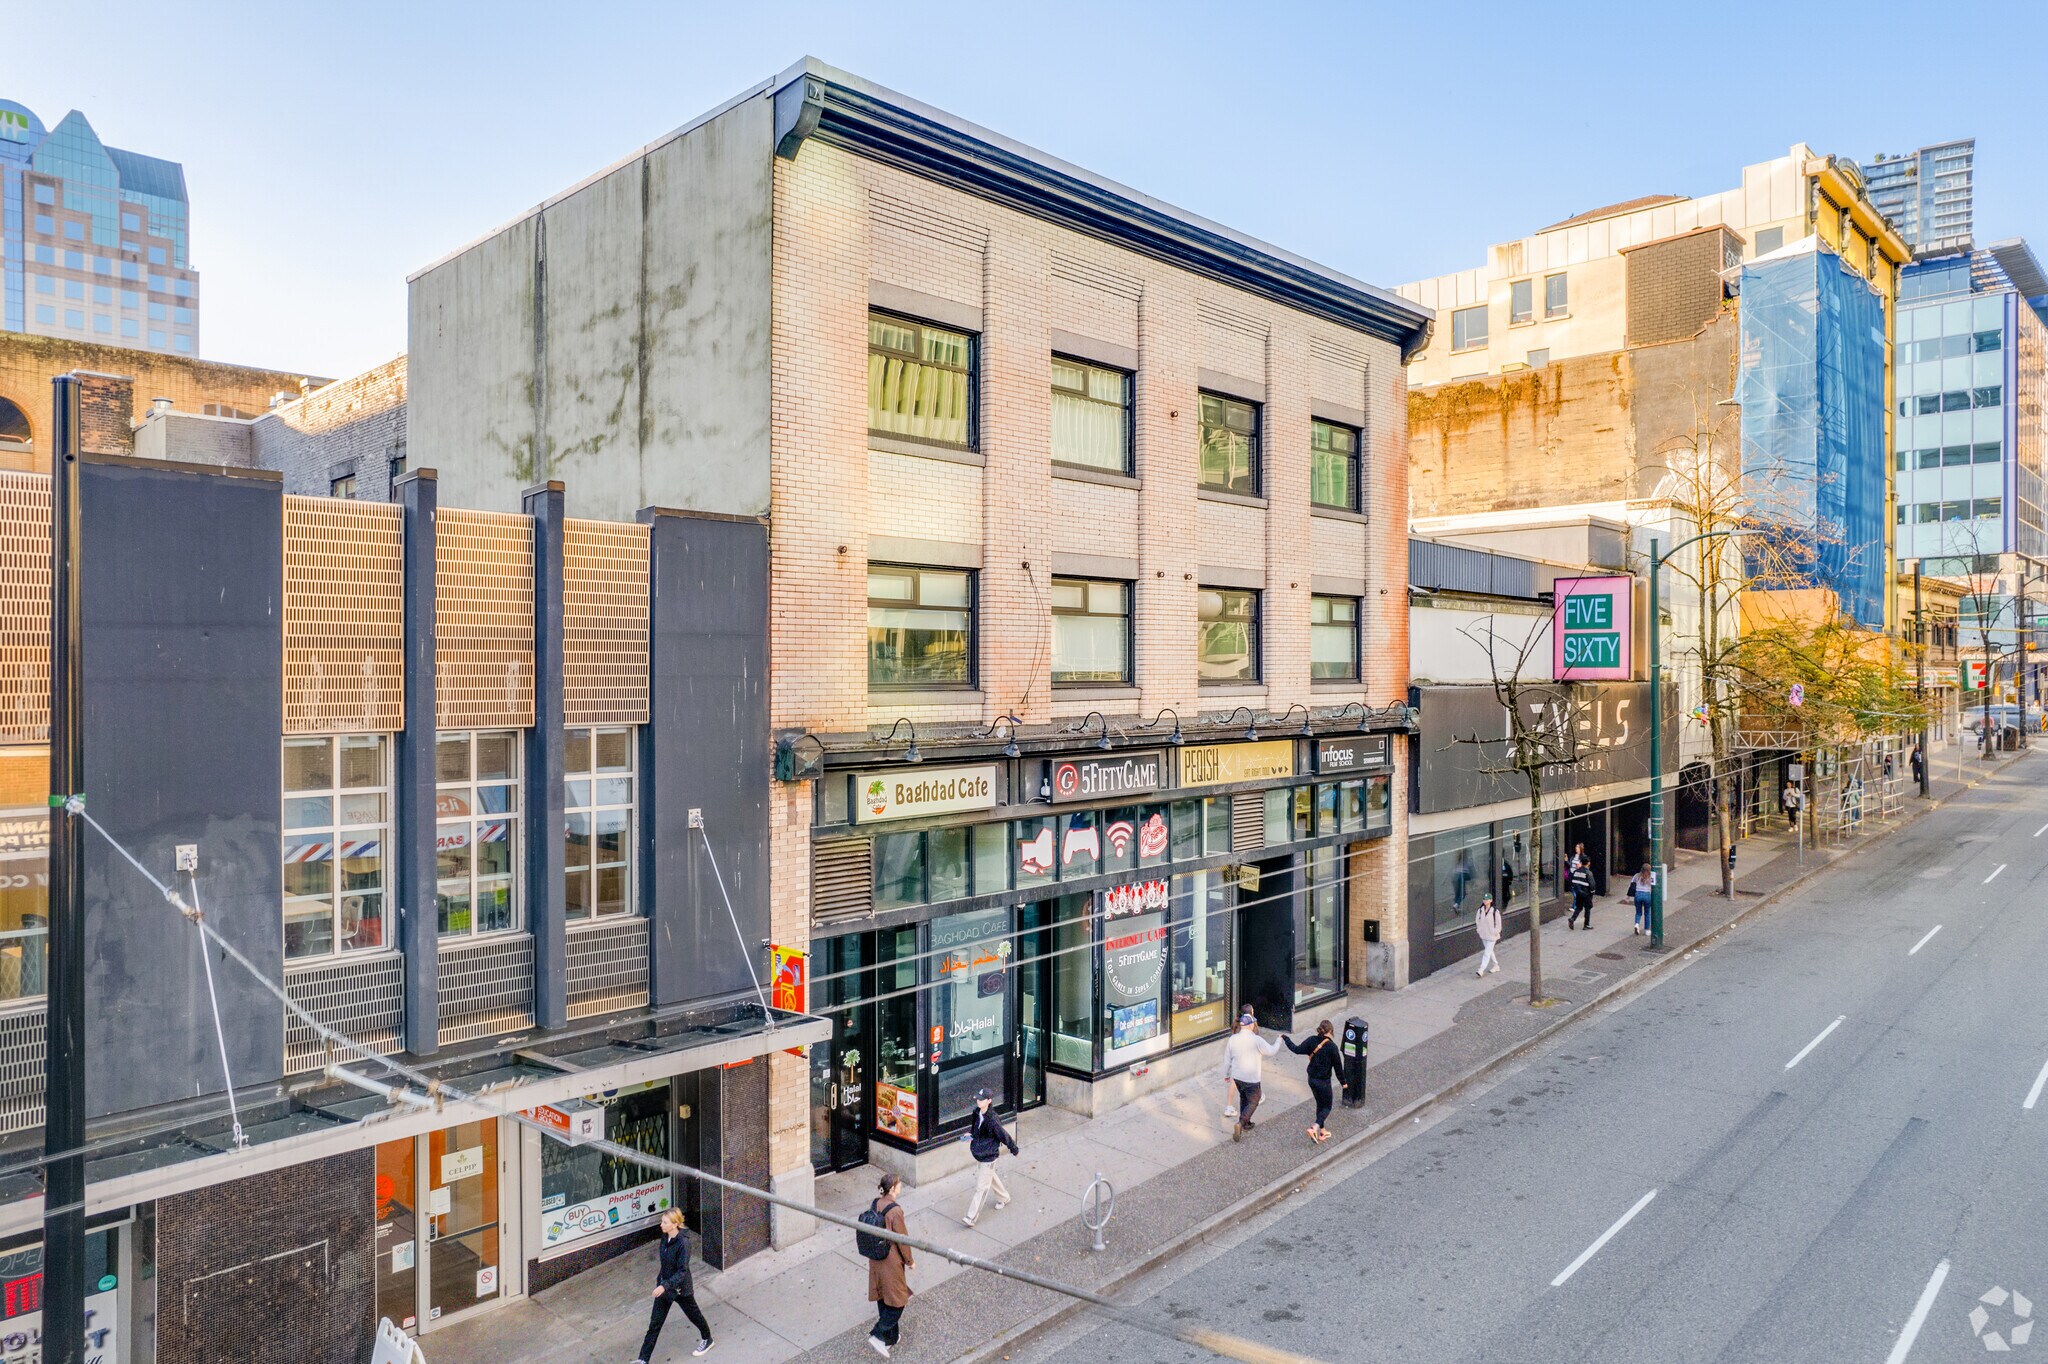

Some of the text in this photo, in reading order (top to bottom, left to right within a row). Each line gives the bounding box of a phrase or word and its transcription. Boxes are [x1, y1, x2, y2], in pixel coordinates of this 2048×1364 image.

[1565, 597, 1607, 624] FIVE
[1564, 636, 1620, 662] SIXTY
[1321, 745, 1354, 763] infocus
[1184, 748, 1220, 784] PEQISH
[1061, 771, 1074, 789] G
[895, 776, 988, 805] Baghdad Cafe
[867, 795, 888, 805] Baghdad
[931, 920, 1008, 948] BAGHDAD CAFE
[1105, 932, 1143, 951] INTERNET
[1147, 927, 1168, 943] CAFE
[971, 1014, 995, 1031] Halal
[843, 1083, 861, 1096] Halal
[538, 1107, 563, 1124] EDUCATION
[608, 1183, 664, 1205] Phone Repairs
[568, 1207, 586, 1221] BUY
[582, 1214, 604, 1228] SELL
